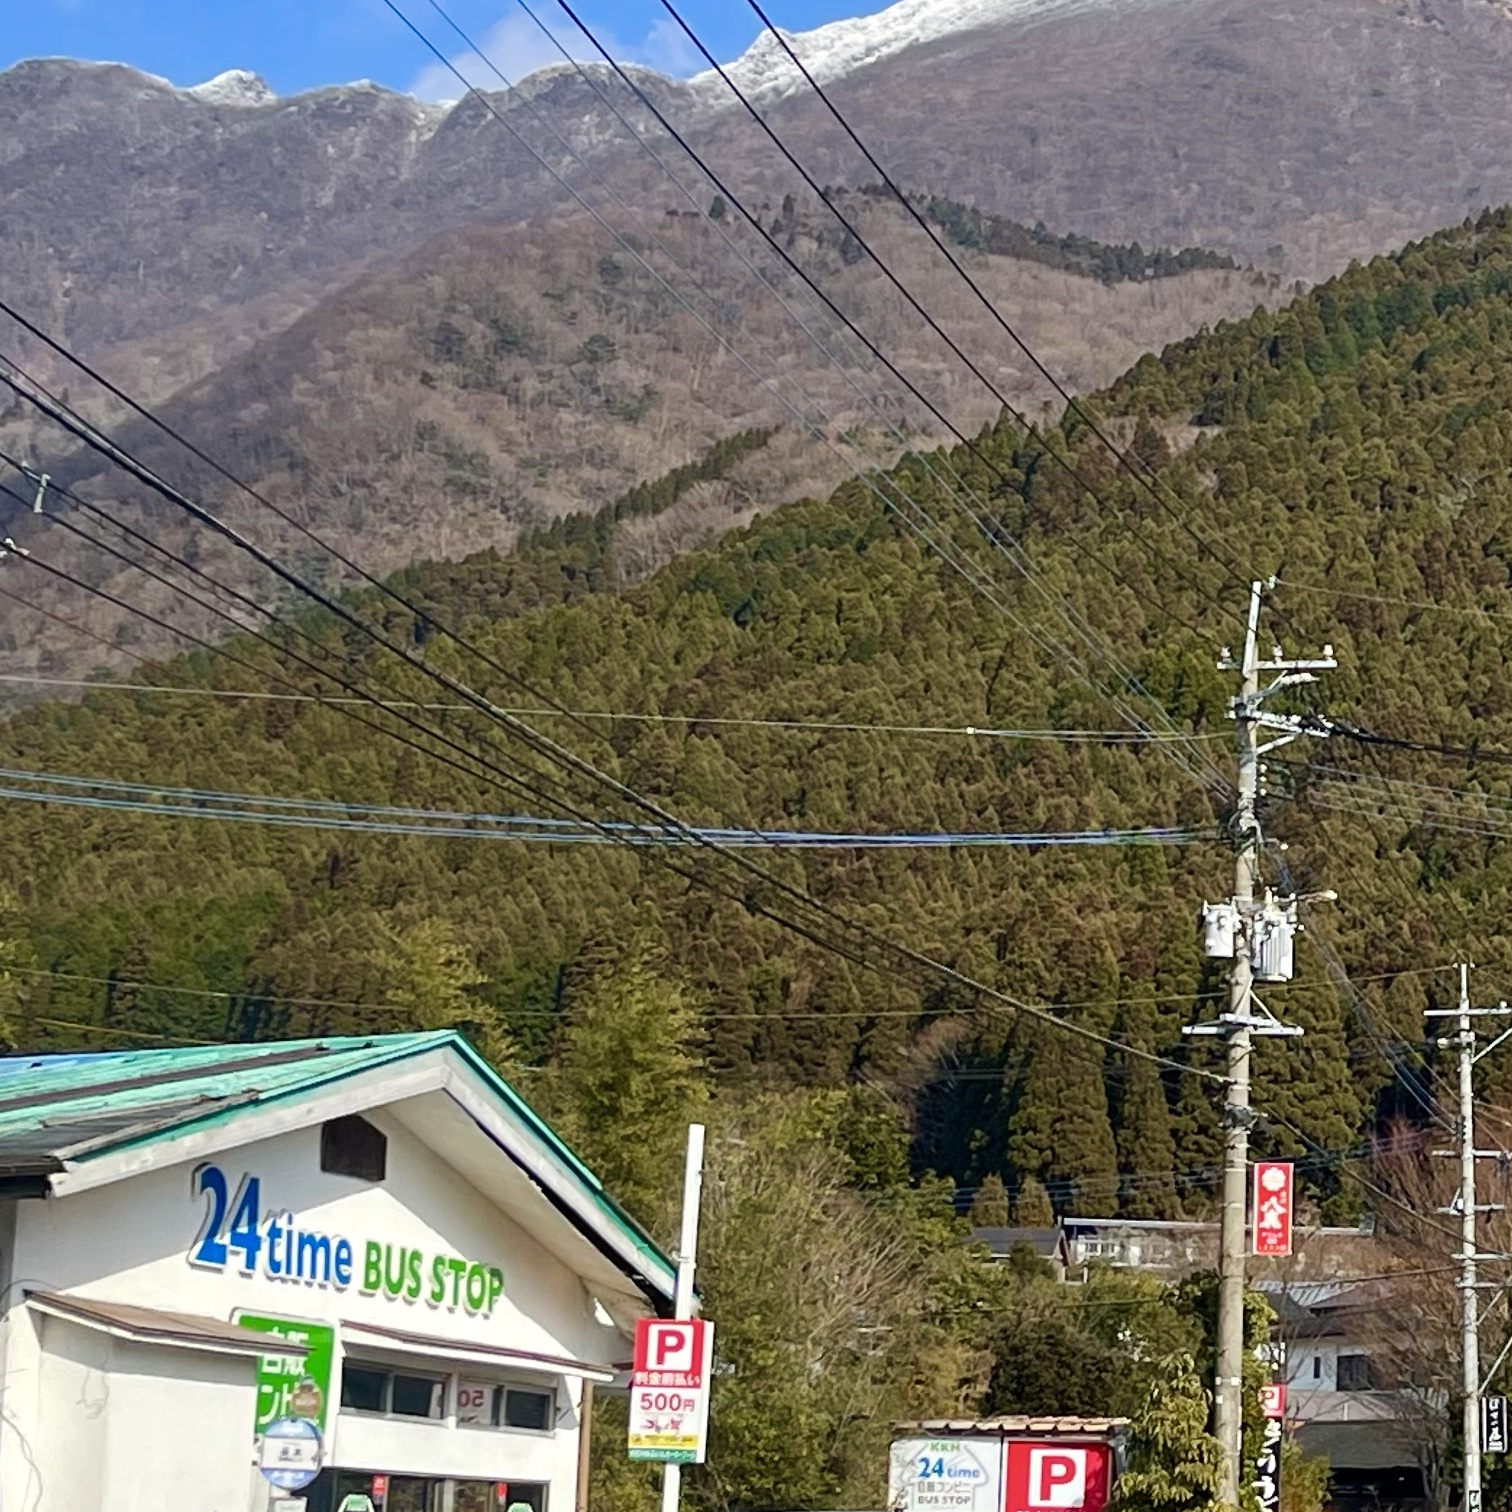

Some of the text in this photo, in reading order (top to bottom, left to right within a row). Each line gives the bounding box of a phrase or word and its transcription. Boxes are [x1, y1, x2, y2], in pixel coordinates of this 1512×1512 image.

[363, 1240, 423, 1299] BUS
[430, 1255, 505, 1313] STOP
[655, 1329, 686, 1365] P
[640, 1391, 696, 1413] 500円
[1040, 1456, 1076, 1501] P
[917, 1496, 972, 1506] BUS STOP
